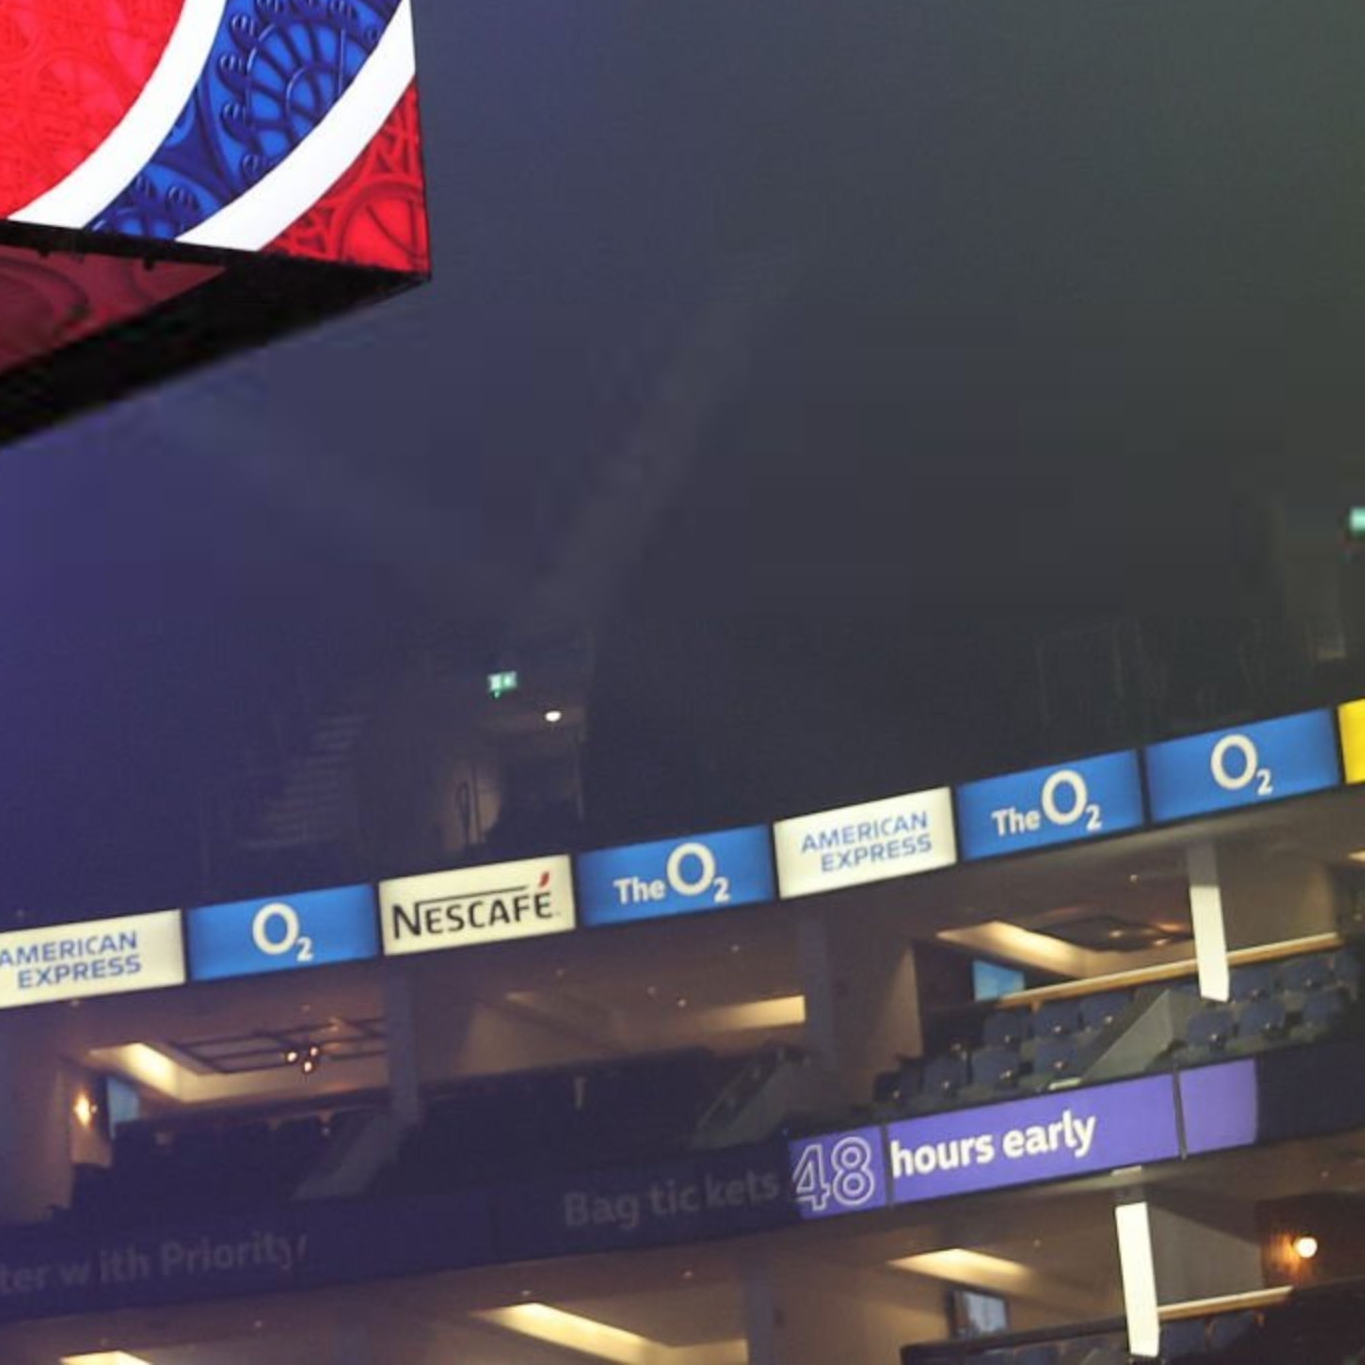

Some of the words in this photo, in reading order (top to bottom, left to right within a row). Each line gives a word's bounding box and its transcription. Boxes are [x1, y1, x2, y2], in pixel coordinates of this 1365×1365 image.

[800, 810, 929, 854] AMERICAN
[991, 807, 1041, 837] The
[819, 833, 933, 873] EXPRESS
[391, 871, 554, 940] NESCAFÉ
[613, 876, 666, 905] The
[16, 954, 142, 991] EXPRESS
[563, 1189, 640, 1232] Bag
[648, 1169, 780, 1217] tickets
[791, 1136, 876, 1213] 48
[891, 1138, 994, 1179] hours
[1002, 1109, 1097, 1159] early
[160, 1233, 310, 1279] Priority
